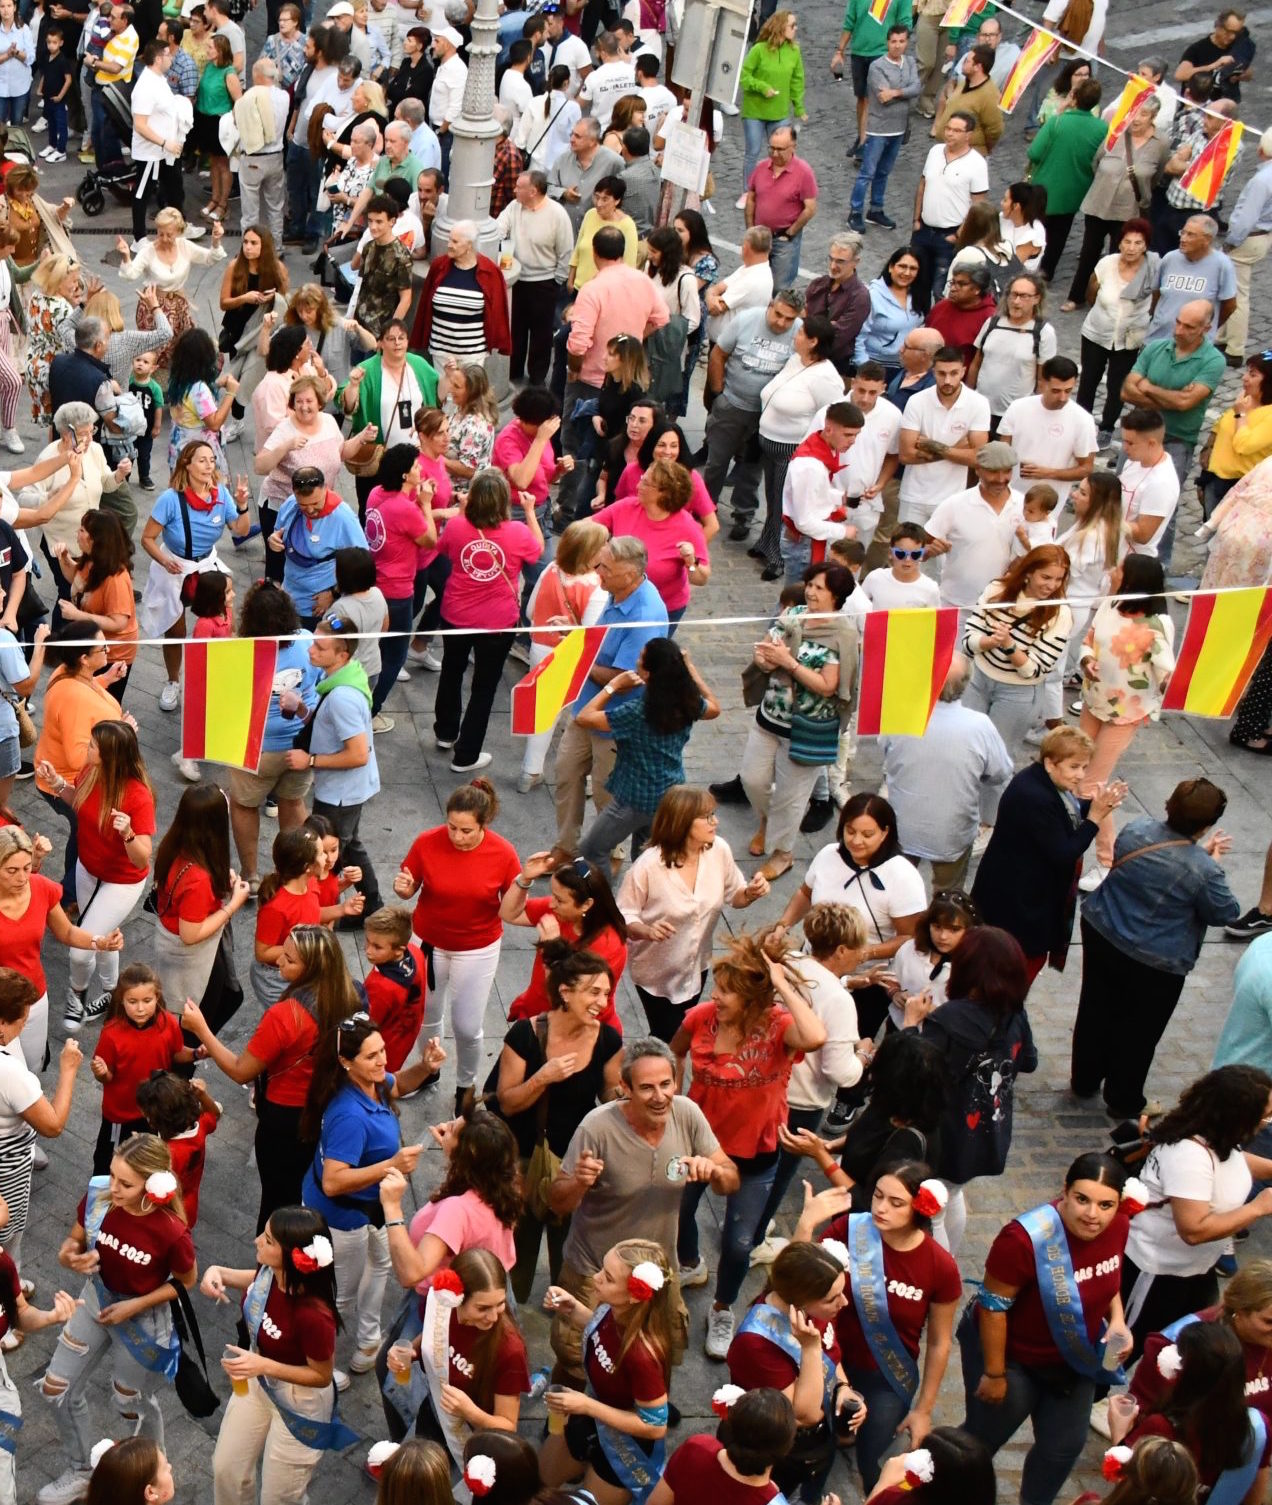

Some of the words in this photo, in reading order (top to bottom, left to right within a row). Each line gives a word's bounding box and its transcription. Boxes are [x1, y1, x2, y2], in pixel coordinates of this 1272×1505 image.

[1168, 274, 1207, 293] POLO
[119, 1243, 152, 1266] 2023
[1095, 1254, 1120, 1277] 2023
[887, 1279, 923, 1301] 2023
[1051, 1265, 1072, 1306] HONOR
